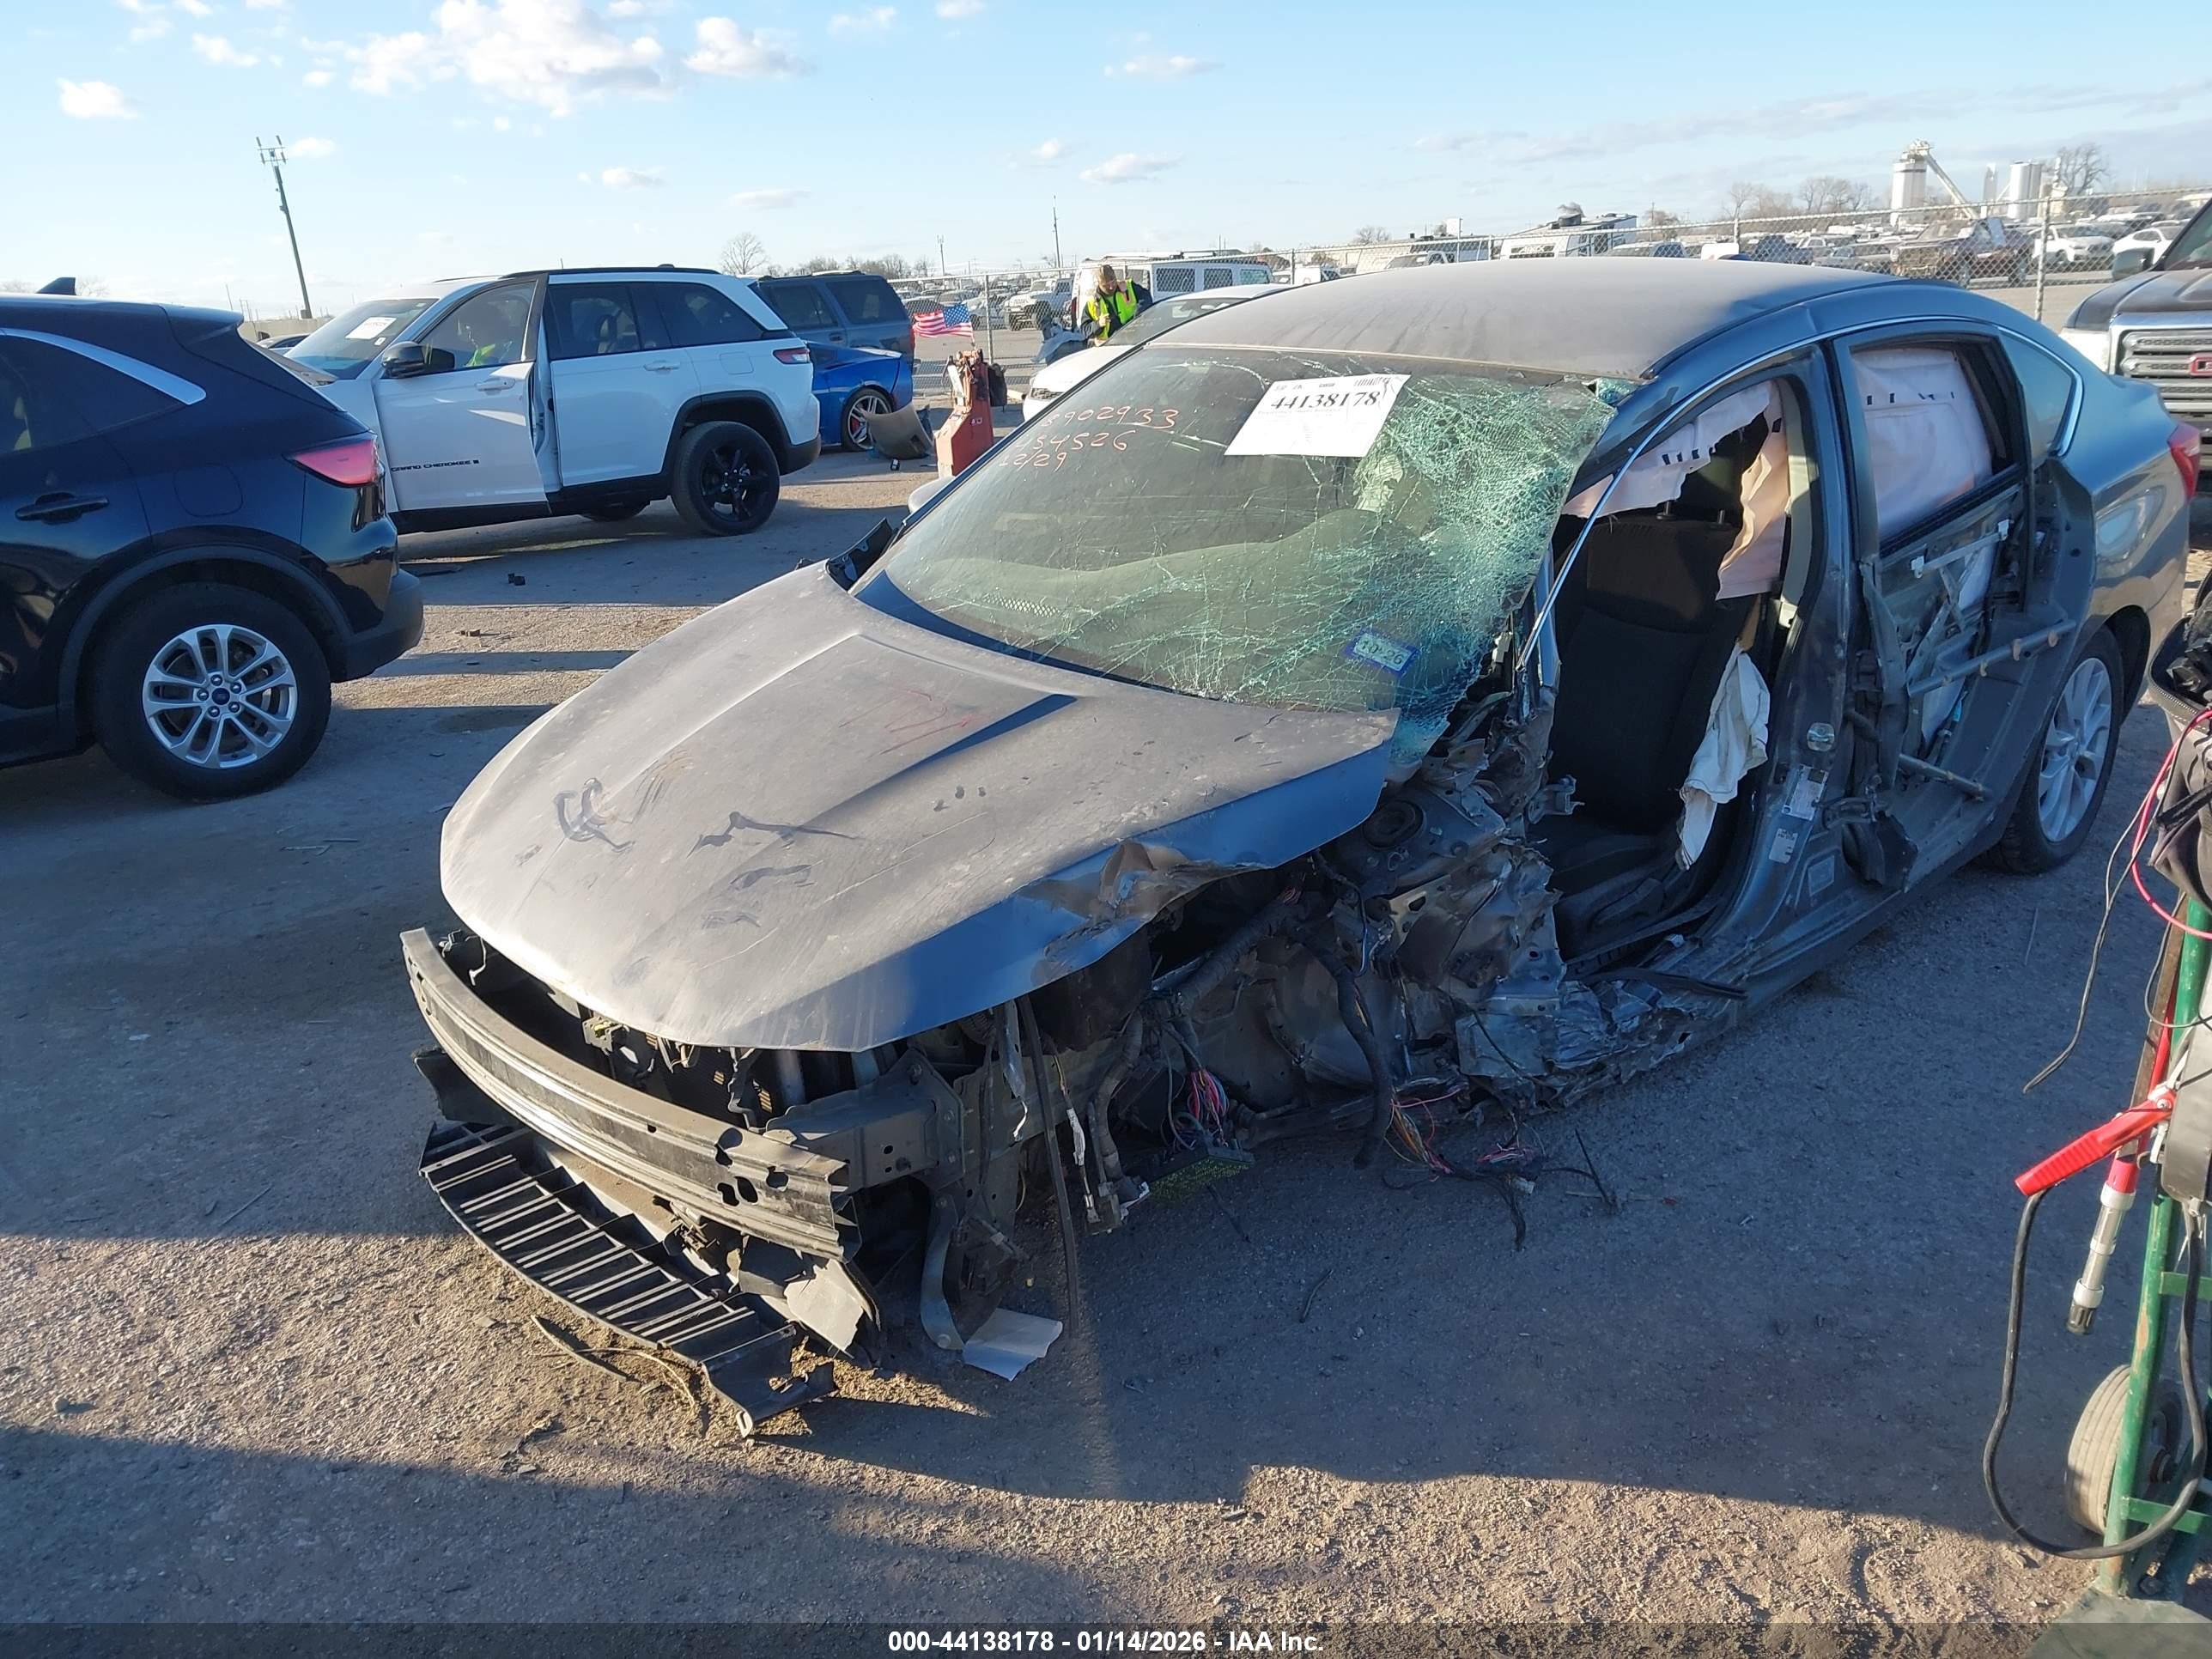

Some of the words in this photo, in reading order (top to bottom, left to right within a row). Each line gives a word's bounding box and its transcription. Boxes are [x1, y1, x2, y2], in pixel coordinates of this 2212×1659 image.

[1270, 391, 1382, 410] 44138178
[999, 448, 1068, 472] 12/29
[1381, 649, 1404, 665] 26
